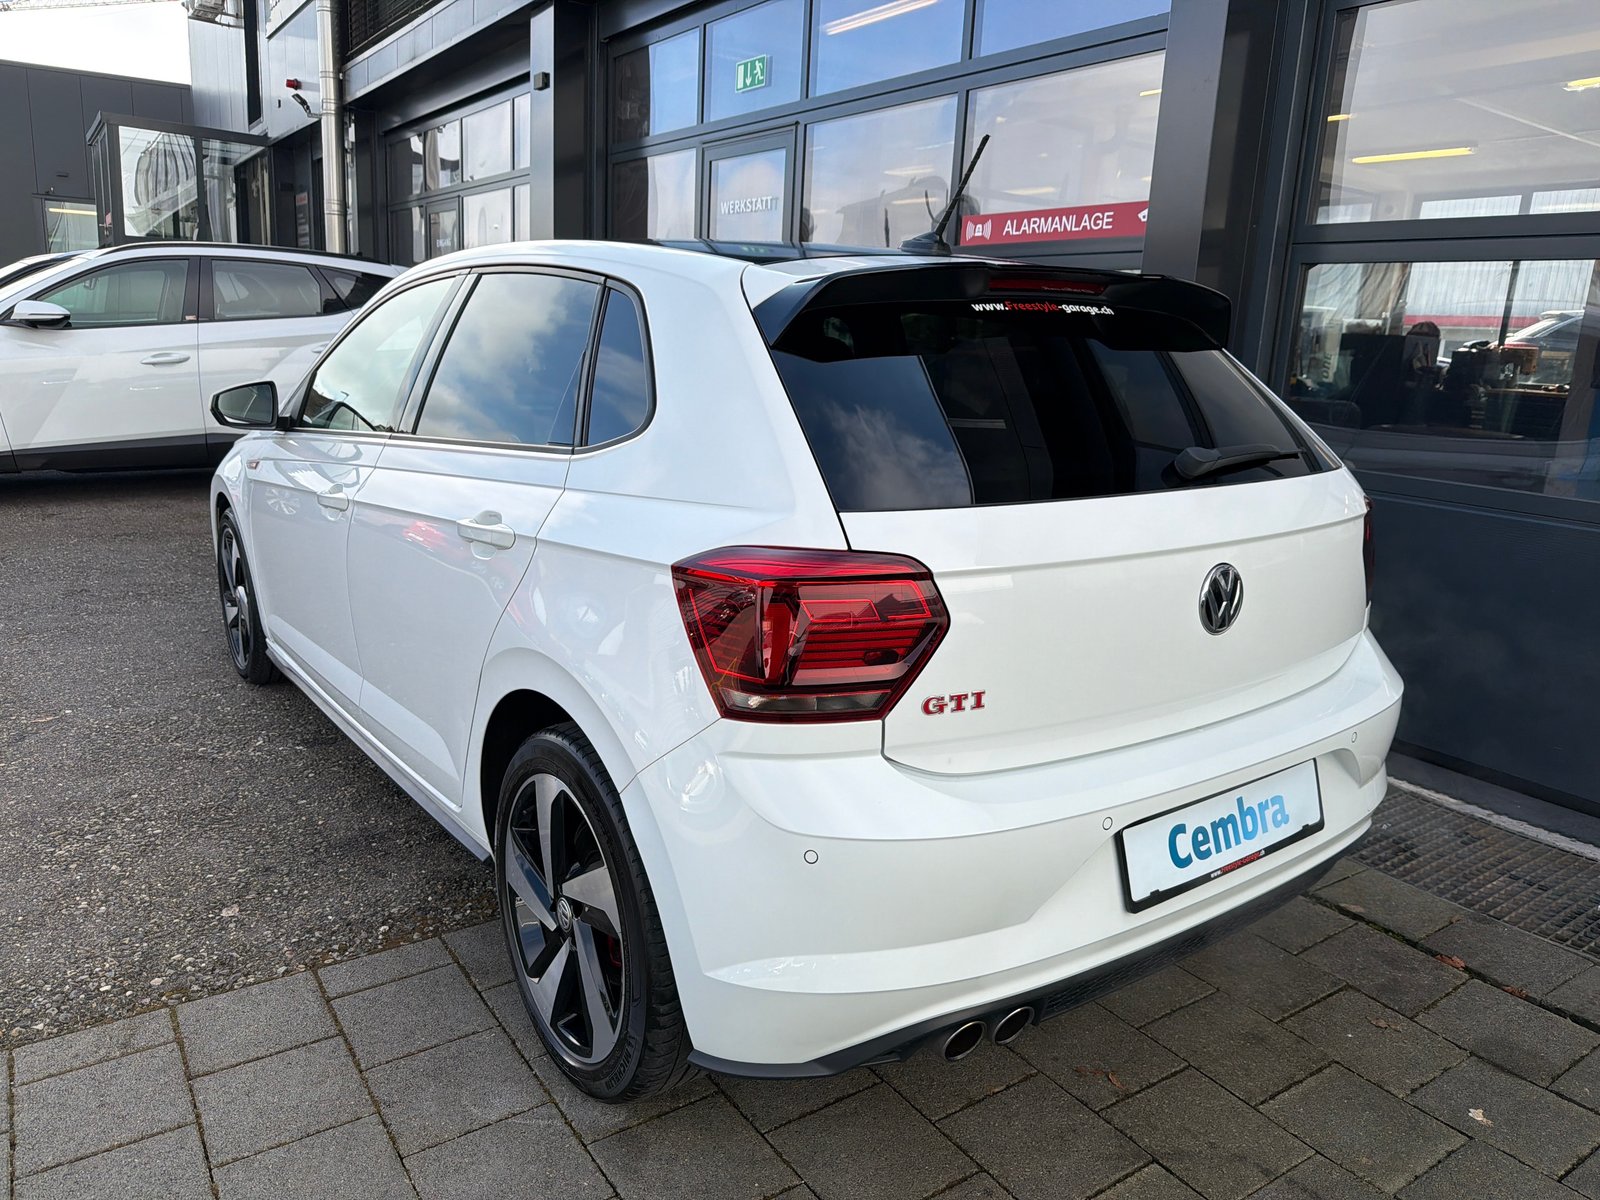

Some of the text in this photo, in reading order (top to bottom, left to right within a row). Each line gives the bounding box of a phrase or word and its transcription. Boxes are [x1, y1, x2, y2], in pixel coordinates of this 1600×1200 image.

[720, 196, 772, 215] WERKSTATT
[1003, 212, 1114, 236] ALARMANLAGE
[971, 301, 1115, 316] www.Freestyle-garage.ch
[921, 690, 986, 716] GTI
[1168, 795, 1290, 869] Cembra
